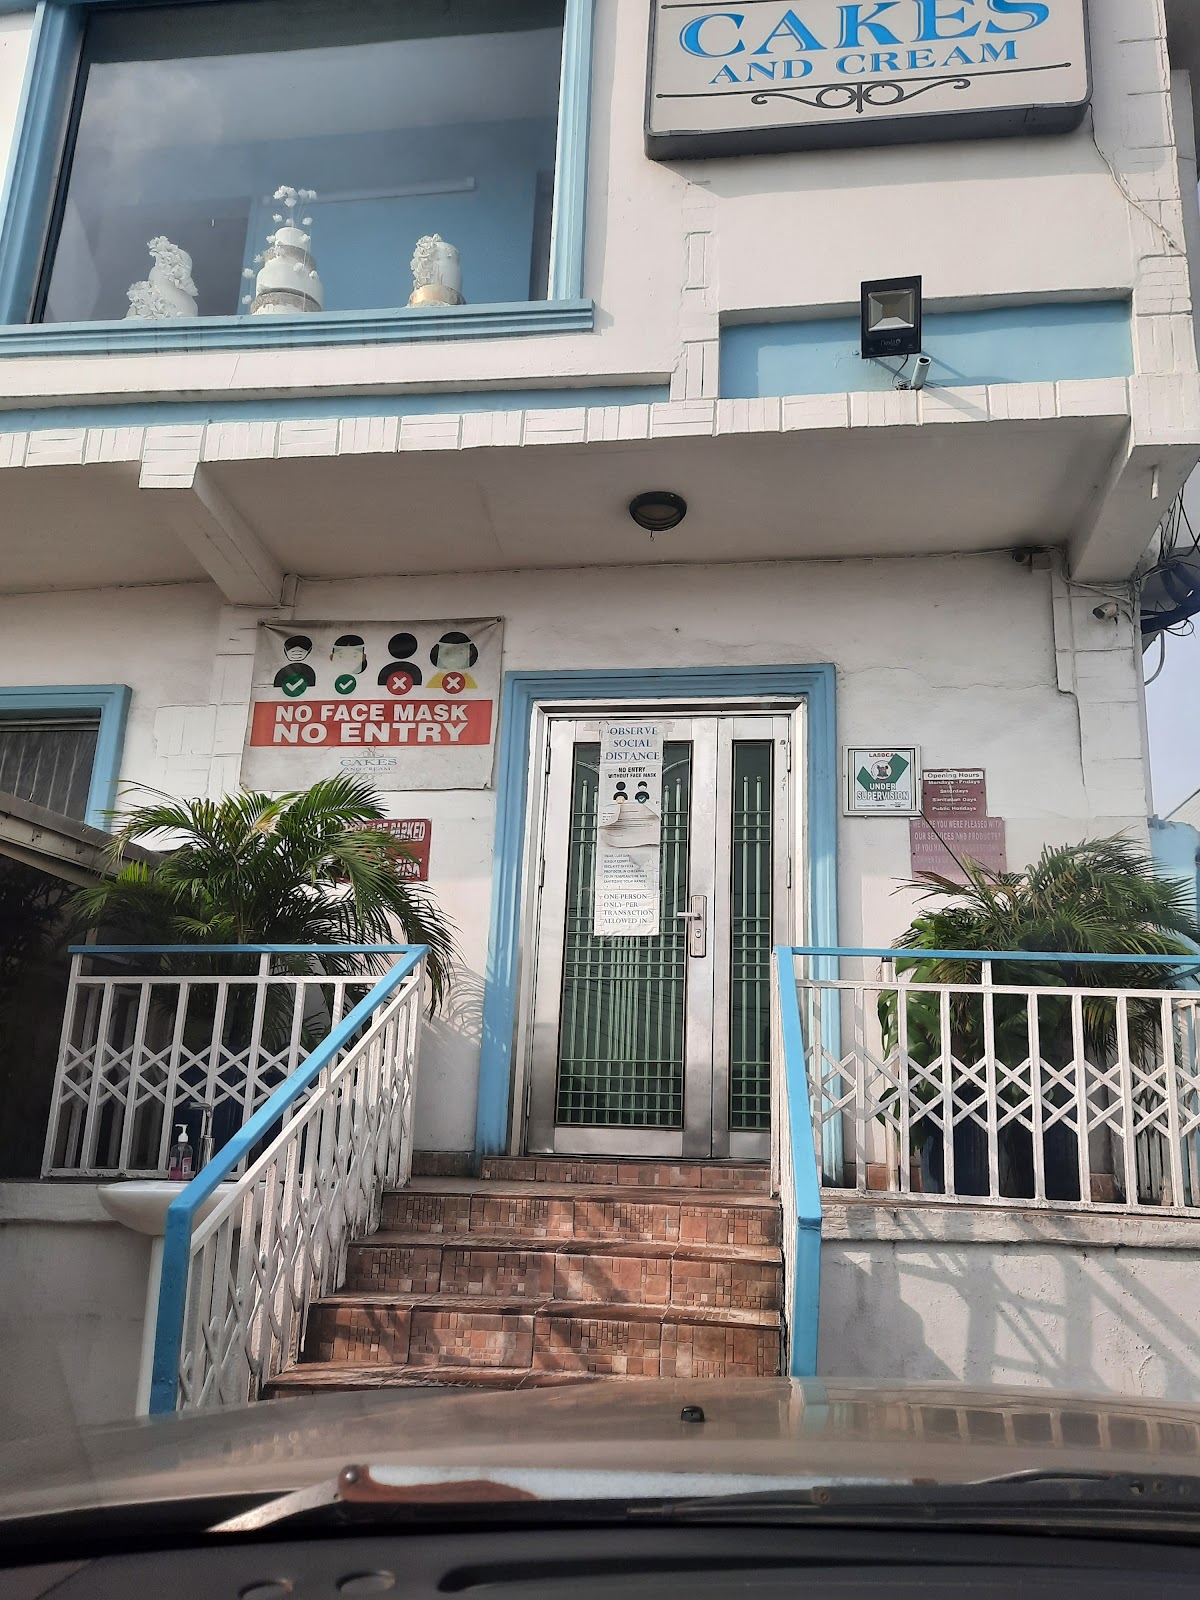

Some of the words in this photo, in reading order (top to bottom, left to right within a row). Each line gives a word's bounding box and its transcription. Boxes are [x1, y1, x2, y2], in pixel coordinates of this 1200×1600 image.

[679, 0, 1050, 58] CAKES
[708, 59, 813, 85] AND
[836, 40, 1019, 75] CREAM
[275, 705, 312, 722] NO
[320, 704, 385, 721] FACE
[393, 704, 469, 721] MASK
[273, 722, 327, 743] NO
[340, 722, 469, 743] ENTRY
[610, 726, 658, 735] OBSERVE
[613, 739, 652, 747] SOCIAL
[605, 752, 660, 760] DISTANCE
[340, 758, 397, 766] CAKES
[869, 782, 897, 791] UNDER
[857, 790, 909, 801] SUPERVISION
[937, 820, 948, 828] YOU
[948, 820, 963, 828] WERE
[964, 820, 988, 828] PLEASED
[390, 820, 426, 842] PARKED
[914, 832, 926, 840] OUR
[915, 844, 920, 852] IF
[921, 844, 933, 852] YOU
